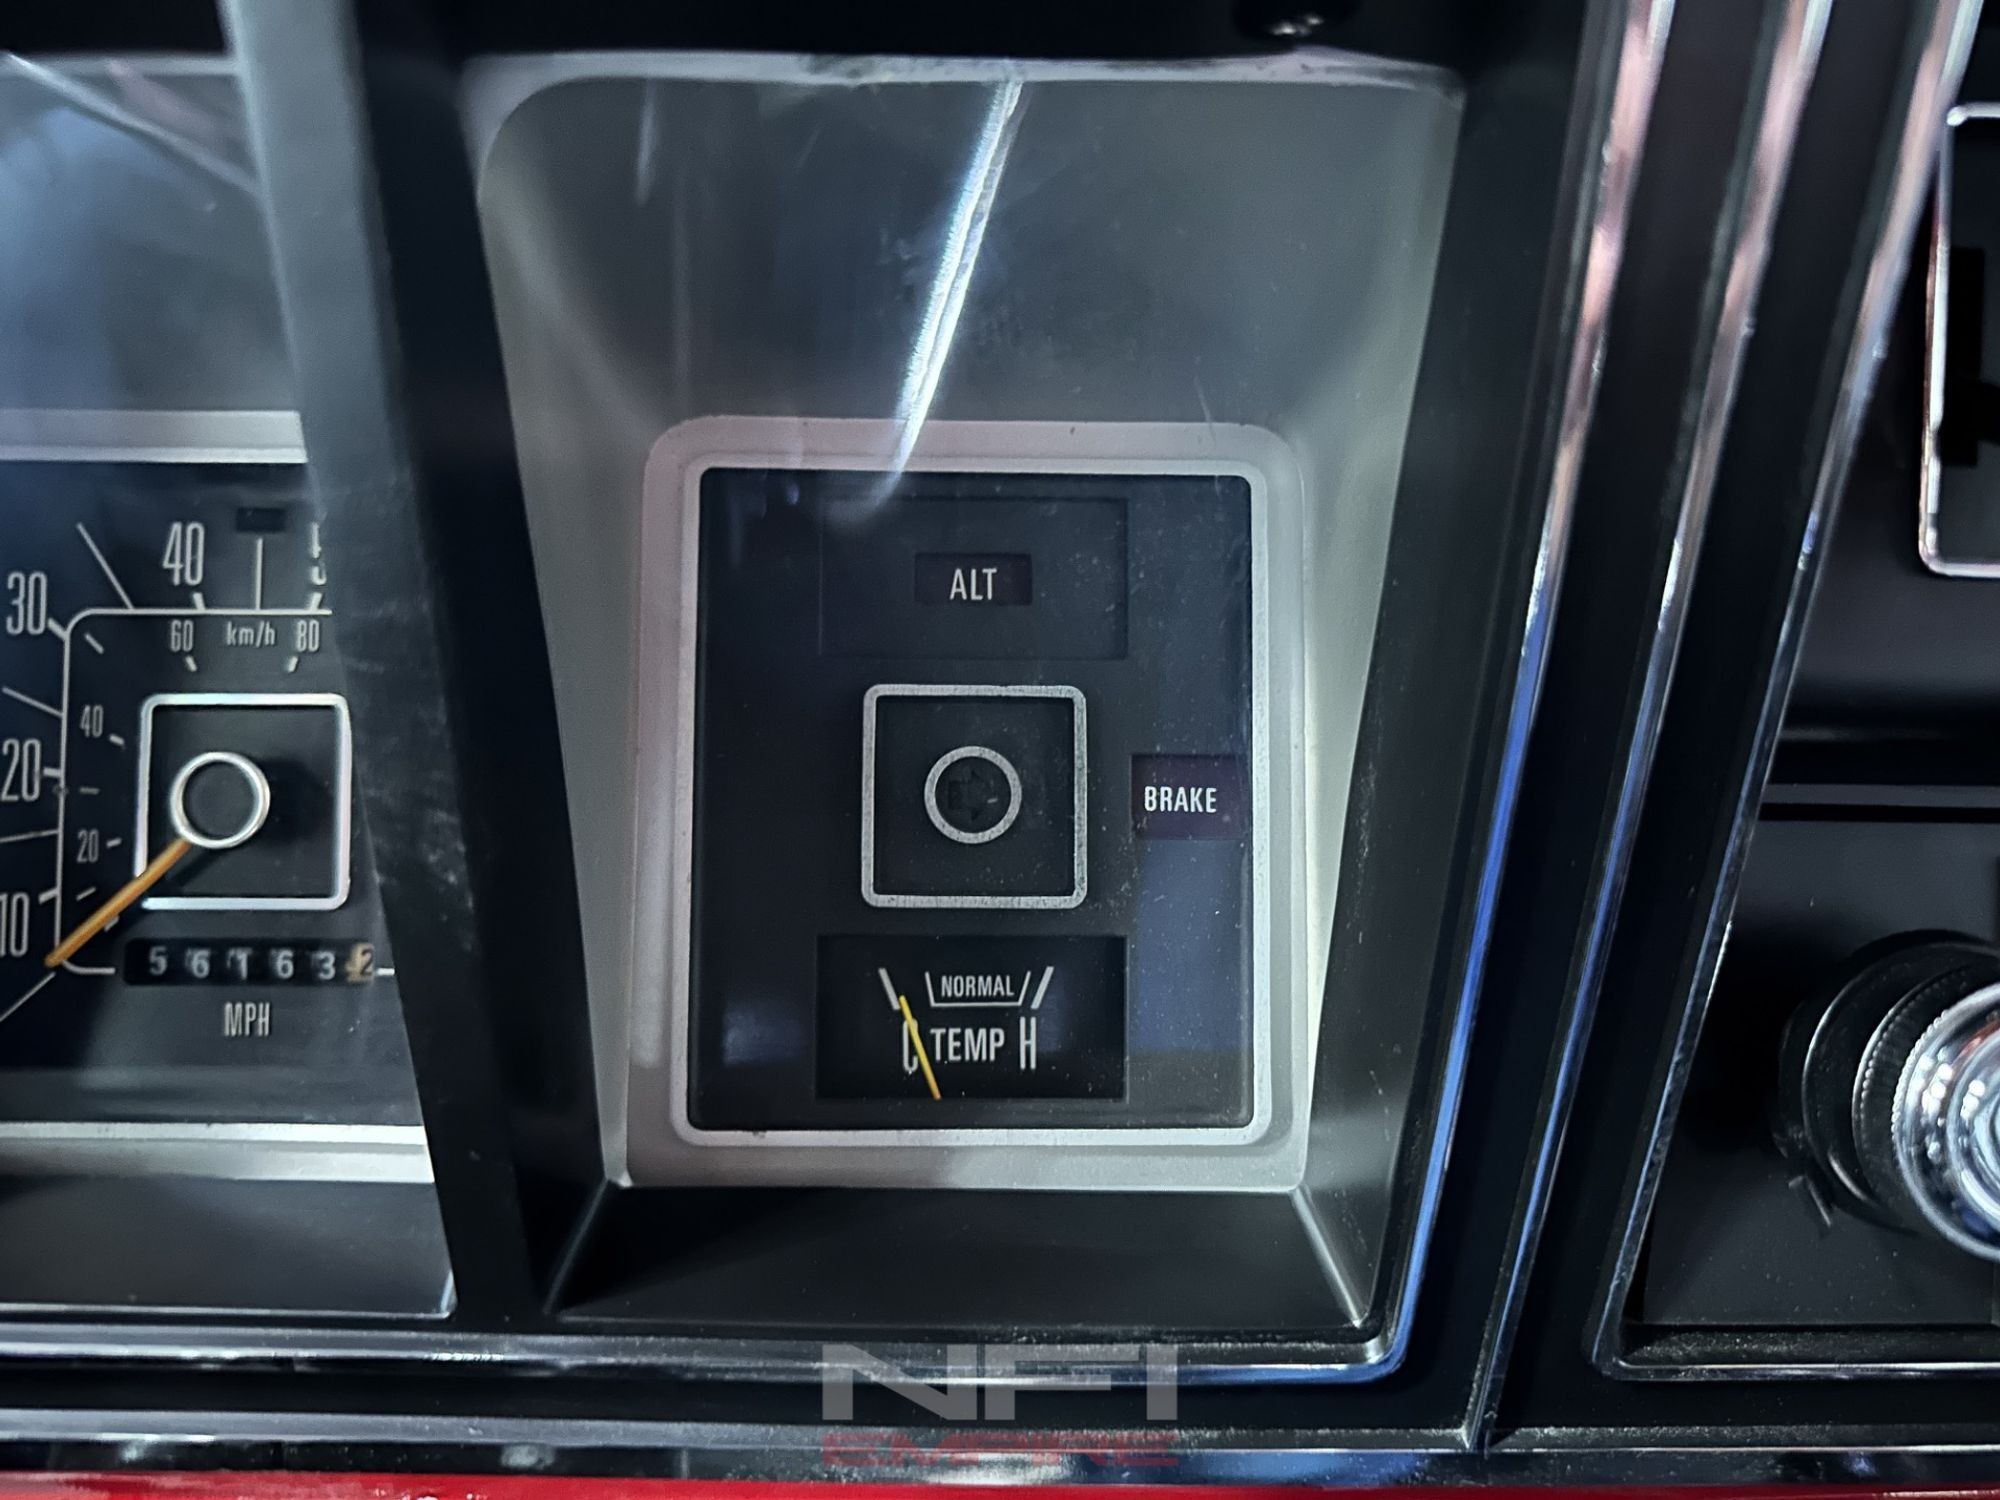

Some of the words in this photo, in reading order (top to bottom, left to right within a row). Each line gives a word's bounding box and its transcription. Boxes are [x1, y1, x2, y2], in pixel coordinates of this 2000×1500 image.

[163, 522, 205, 586] 40
[950, 568, 997, 601] ALT
[6, 572, 48, 634] 30
[170, 620, 194, 652] 60
[227, 622, 275, 648] km/h
[295, 620, 320, 652] 80
[80, 705, 104, 738] 40
[1, 738, 42, 802] 20
[1144, 786, 1217, 813] BRAKE
[77, 829, 99, 863] 20
[941, 975, 1014, 998] NORMAL
[223, 1003, 271, 1037] MPH
[902, 1017, 919, 1073] C
[930, 1028, 1005, 1062] TEMP
[1020, 1016, 1037, 1071] H
